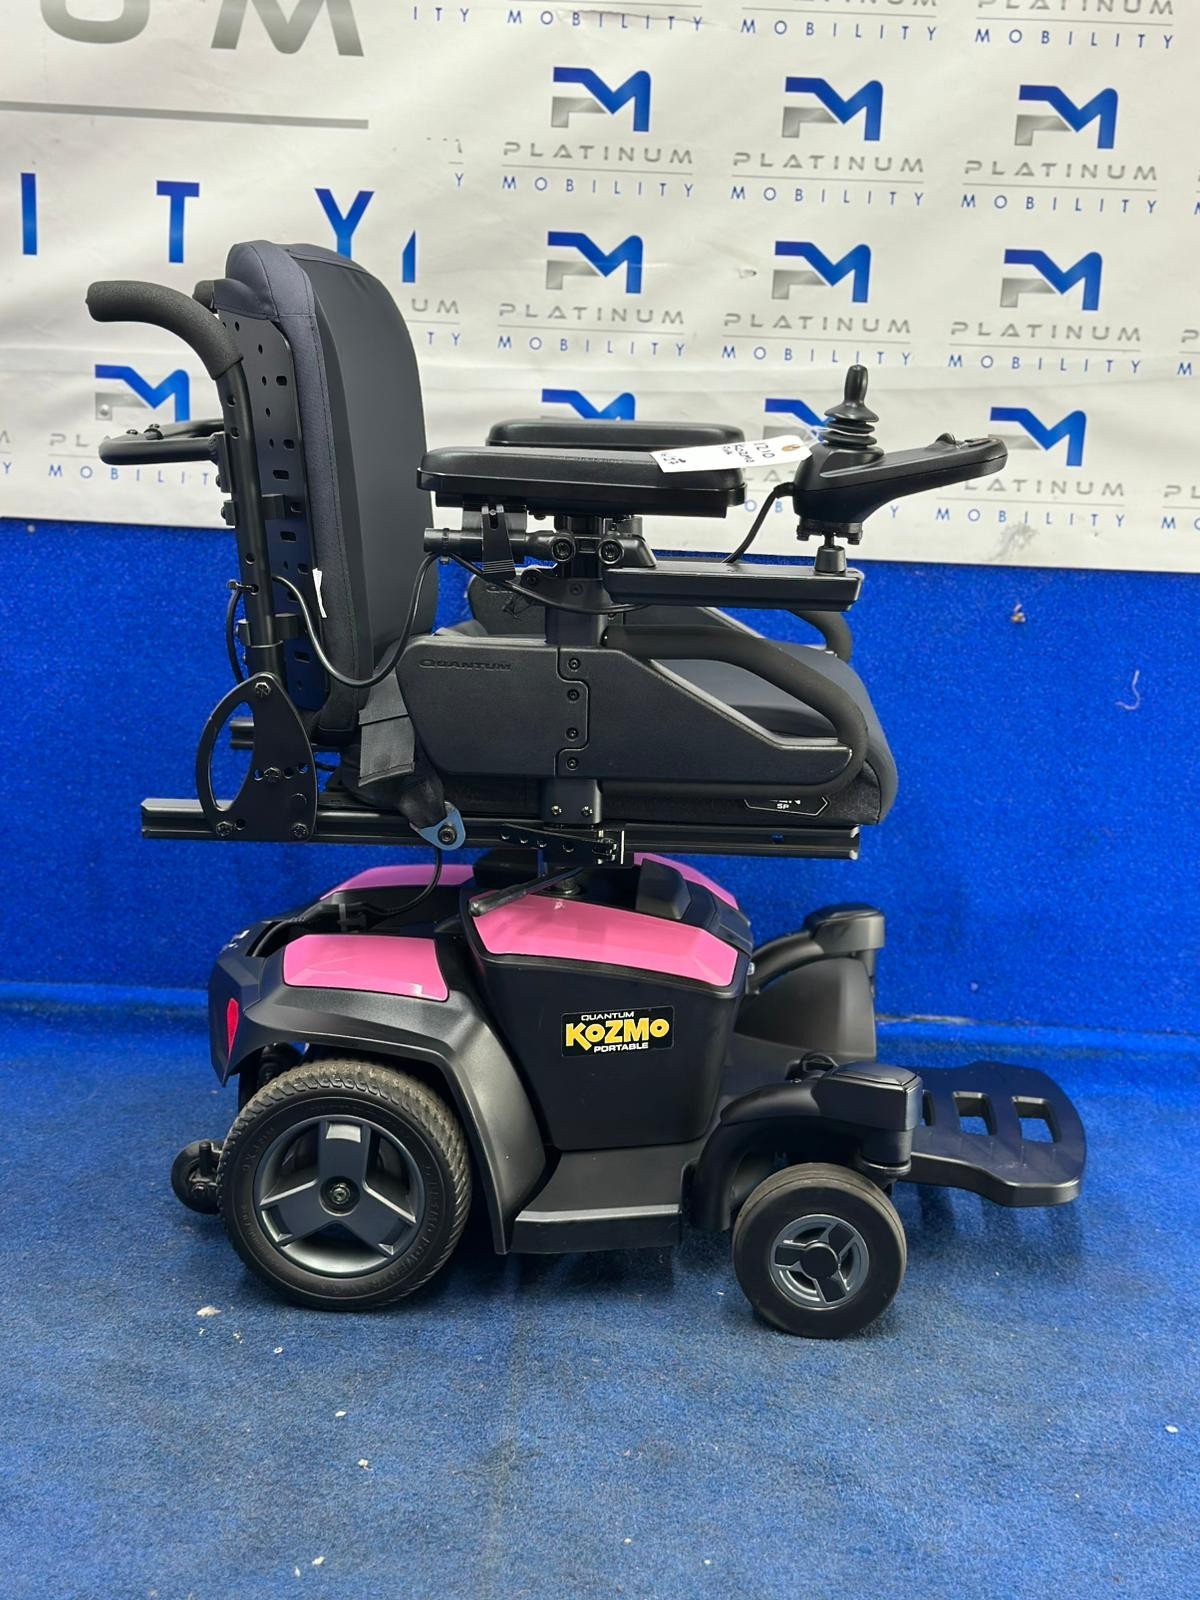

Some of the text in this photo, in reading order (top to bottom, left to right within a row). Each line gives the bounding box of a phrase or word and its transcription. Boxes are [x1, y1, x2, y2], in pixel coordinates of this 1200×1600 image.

[507, 9, 704, 31] MOBILITY
[741, 18, 937, 41] MOBILITY
[975, 28, 1174, 49] MOBILITY
[503, 142, 693, 164] PLATINUM
[733, 152, 924, 173] PLATINUM
[964, 160, 1157, 181] PLATINUM
[502, 176, 693, 198] MOBILITY
[731, 186, 924, 206] MOBILITY
[961, 194, 1157, 214] MOBILITY
[499, 302, 684, 325] PLATINUM
[724, 312, 912, 334] PLATINUM
[950, 321, 1141, 342] PLATINUM
[497, 335, 684, 357] MOBILITY
[721, 345, 912, 366] MOBILITY
[948, 353, 1141, 374] MOBILITY
[964, 478, 1124, 497] LATINUM
[935, 507, 1125, 528] MOBILITY
[580, 1011, 635, 1022] QUANTUM
[593, 1042, 649, 1053] PORTABLE
